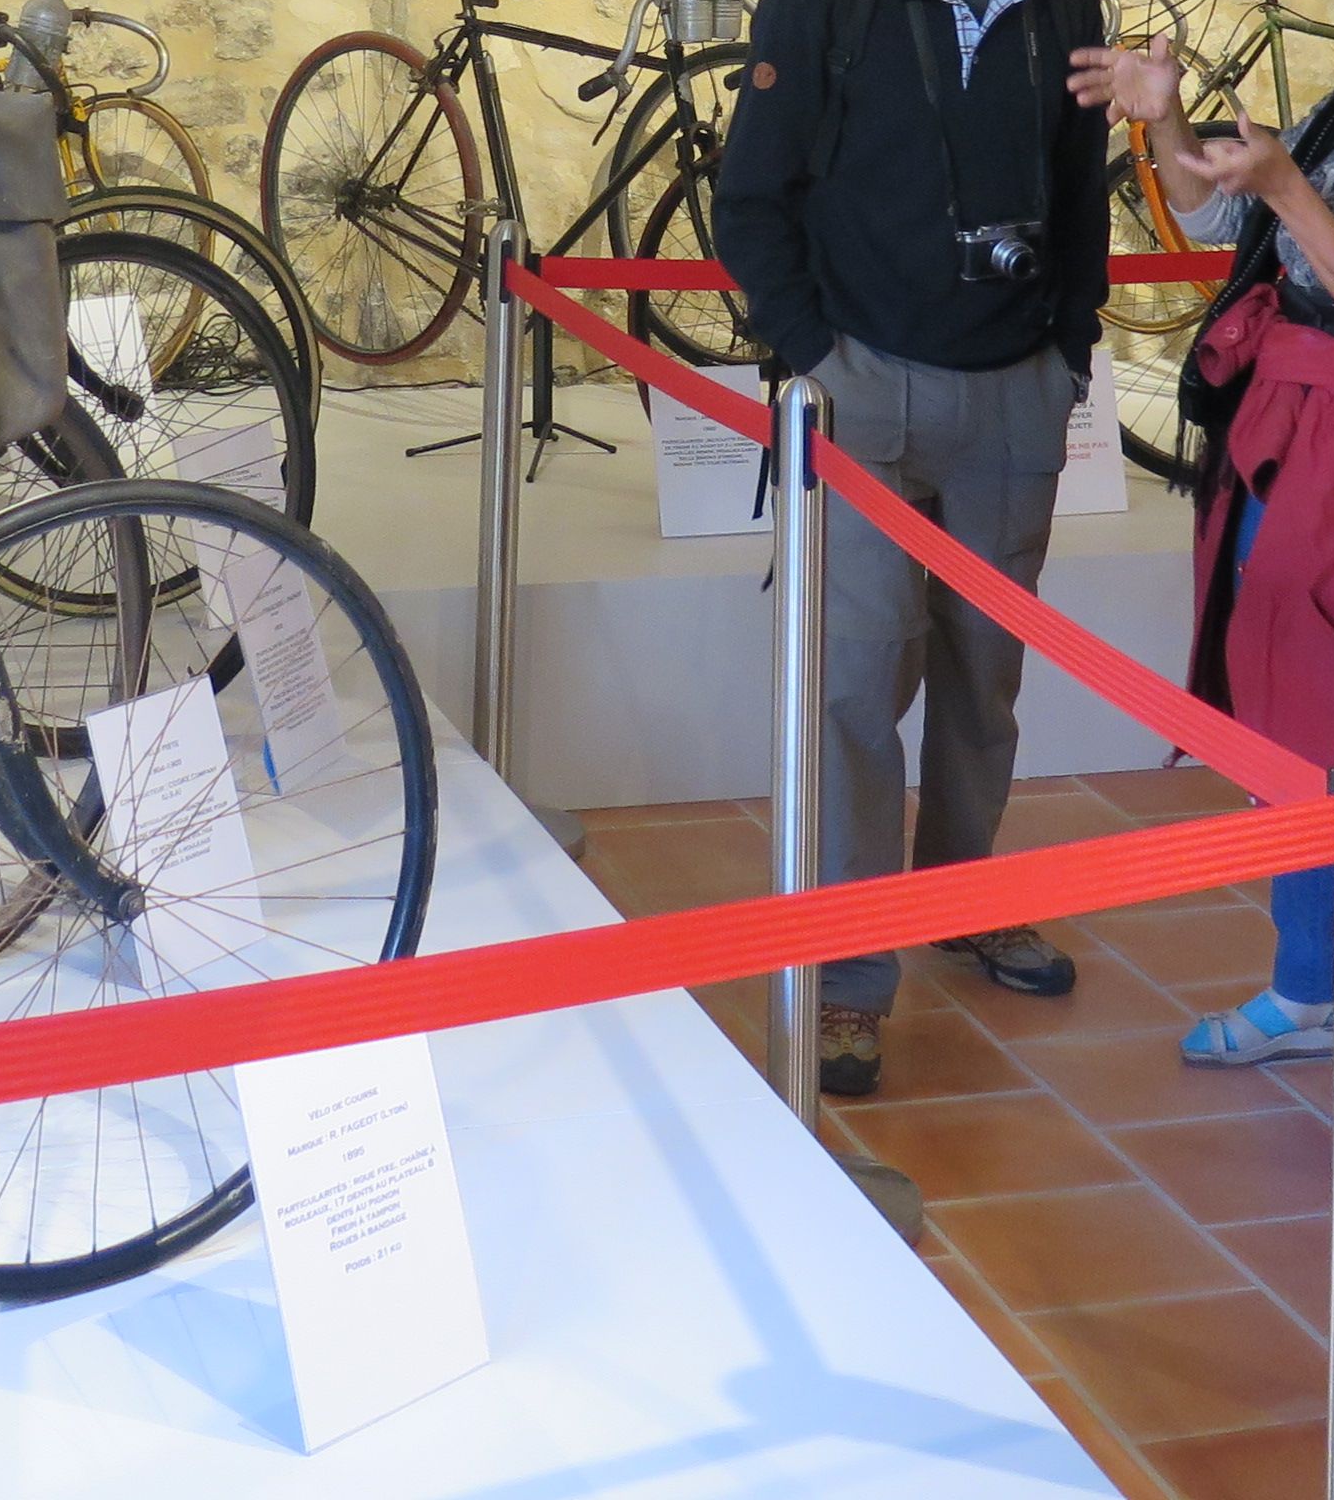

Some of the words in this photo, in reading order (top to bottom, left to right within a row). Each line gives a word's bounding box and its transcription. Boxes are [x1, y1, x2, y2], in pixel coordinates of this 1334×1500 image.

[332, 1101, 343, 1112] DE
[344, 1086, 379, 1107] COURSE
[287, 1136, 324, 1156] MARQUE
[341, 1113, 379, 1136] FAGEOT
[342, 1145, 365, 1162] 1895
[334, 1196, 345, 1207] 17
[347, 1186, 374, 1203] DENTS
[376, 1179, 386, 1190] AU
[326, 1207, 354, 1225] DENTS
[356, 1202, 367, 1213] AU
[369, 1188, 400, 1207] PIGNON
[366, 1201, 401, 1221] TAMPON
[367, 1212, 407, 1235] BANDAGE
[345, 1256, 372, 1273] POIDS
[377, 1248, 388, 1259] 21
